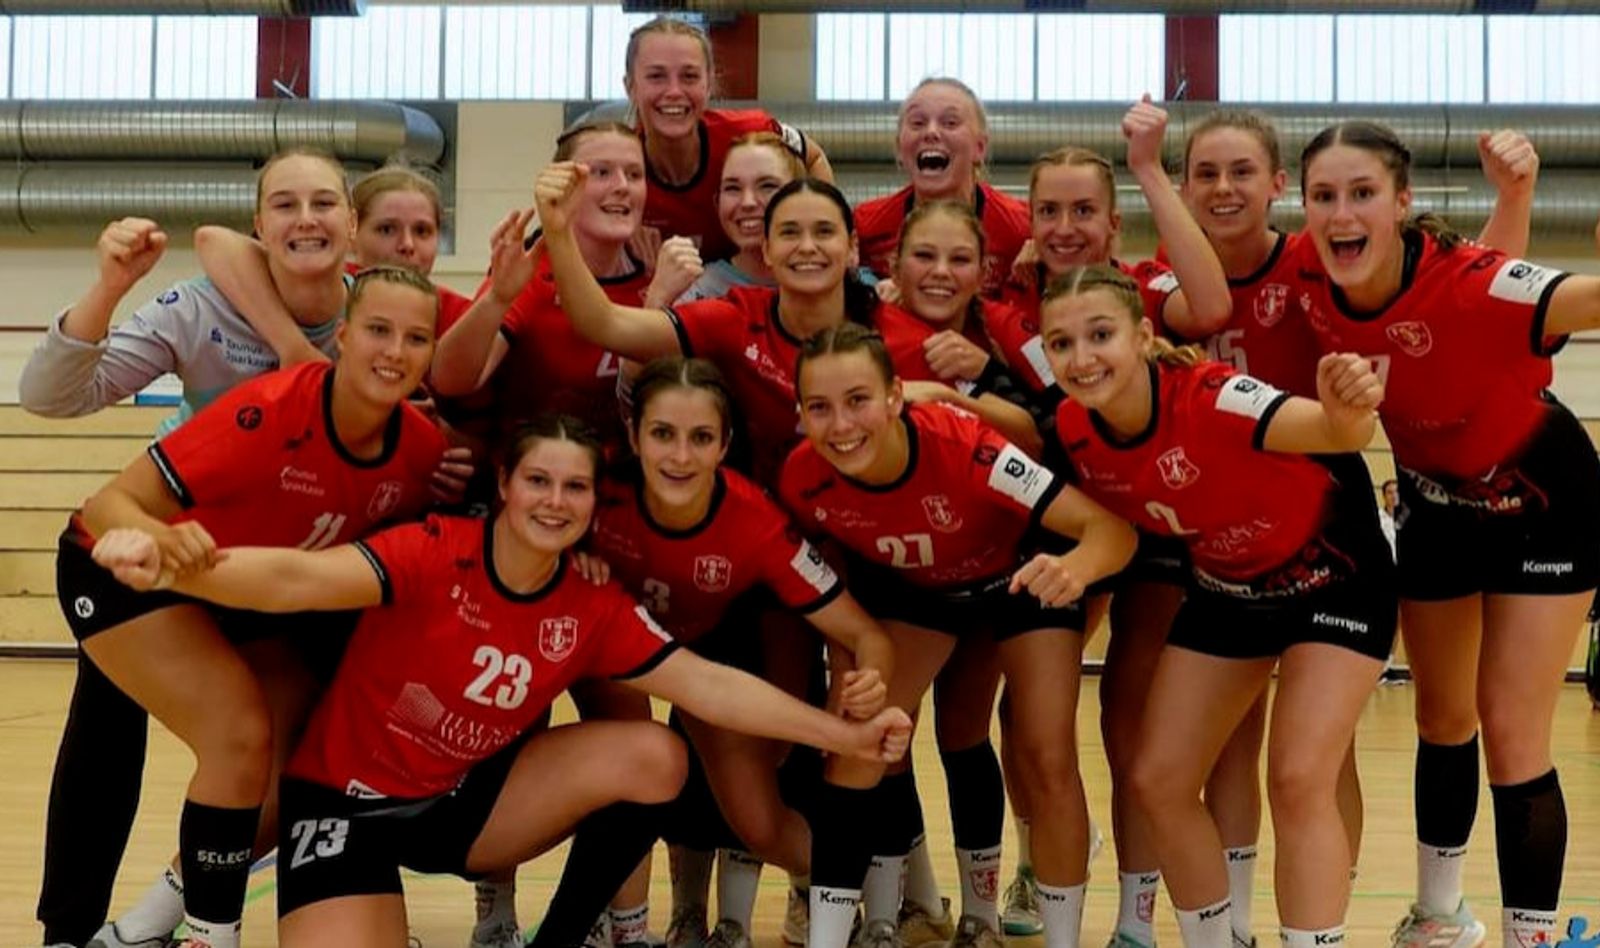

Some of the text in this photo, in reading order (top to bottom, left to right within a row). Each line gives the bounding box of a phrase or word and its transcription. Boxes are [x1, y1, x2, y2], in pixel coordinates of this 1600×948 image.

[296, 511, 347, 551] 11
[876, 533, 934, 568] 27
[1522, 559, 1573, 576] Kempa
[1312, 611, 1369, 635] Kempa
[463, 644, 533, 710] 23
[289, 817, 350, 870] 23
